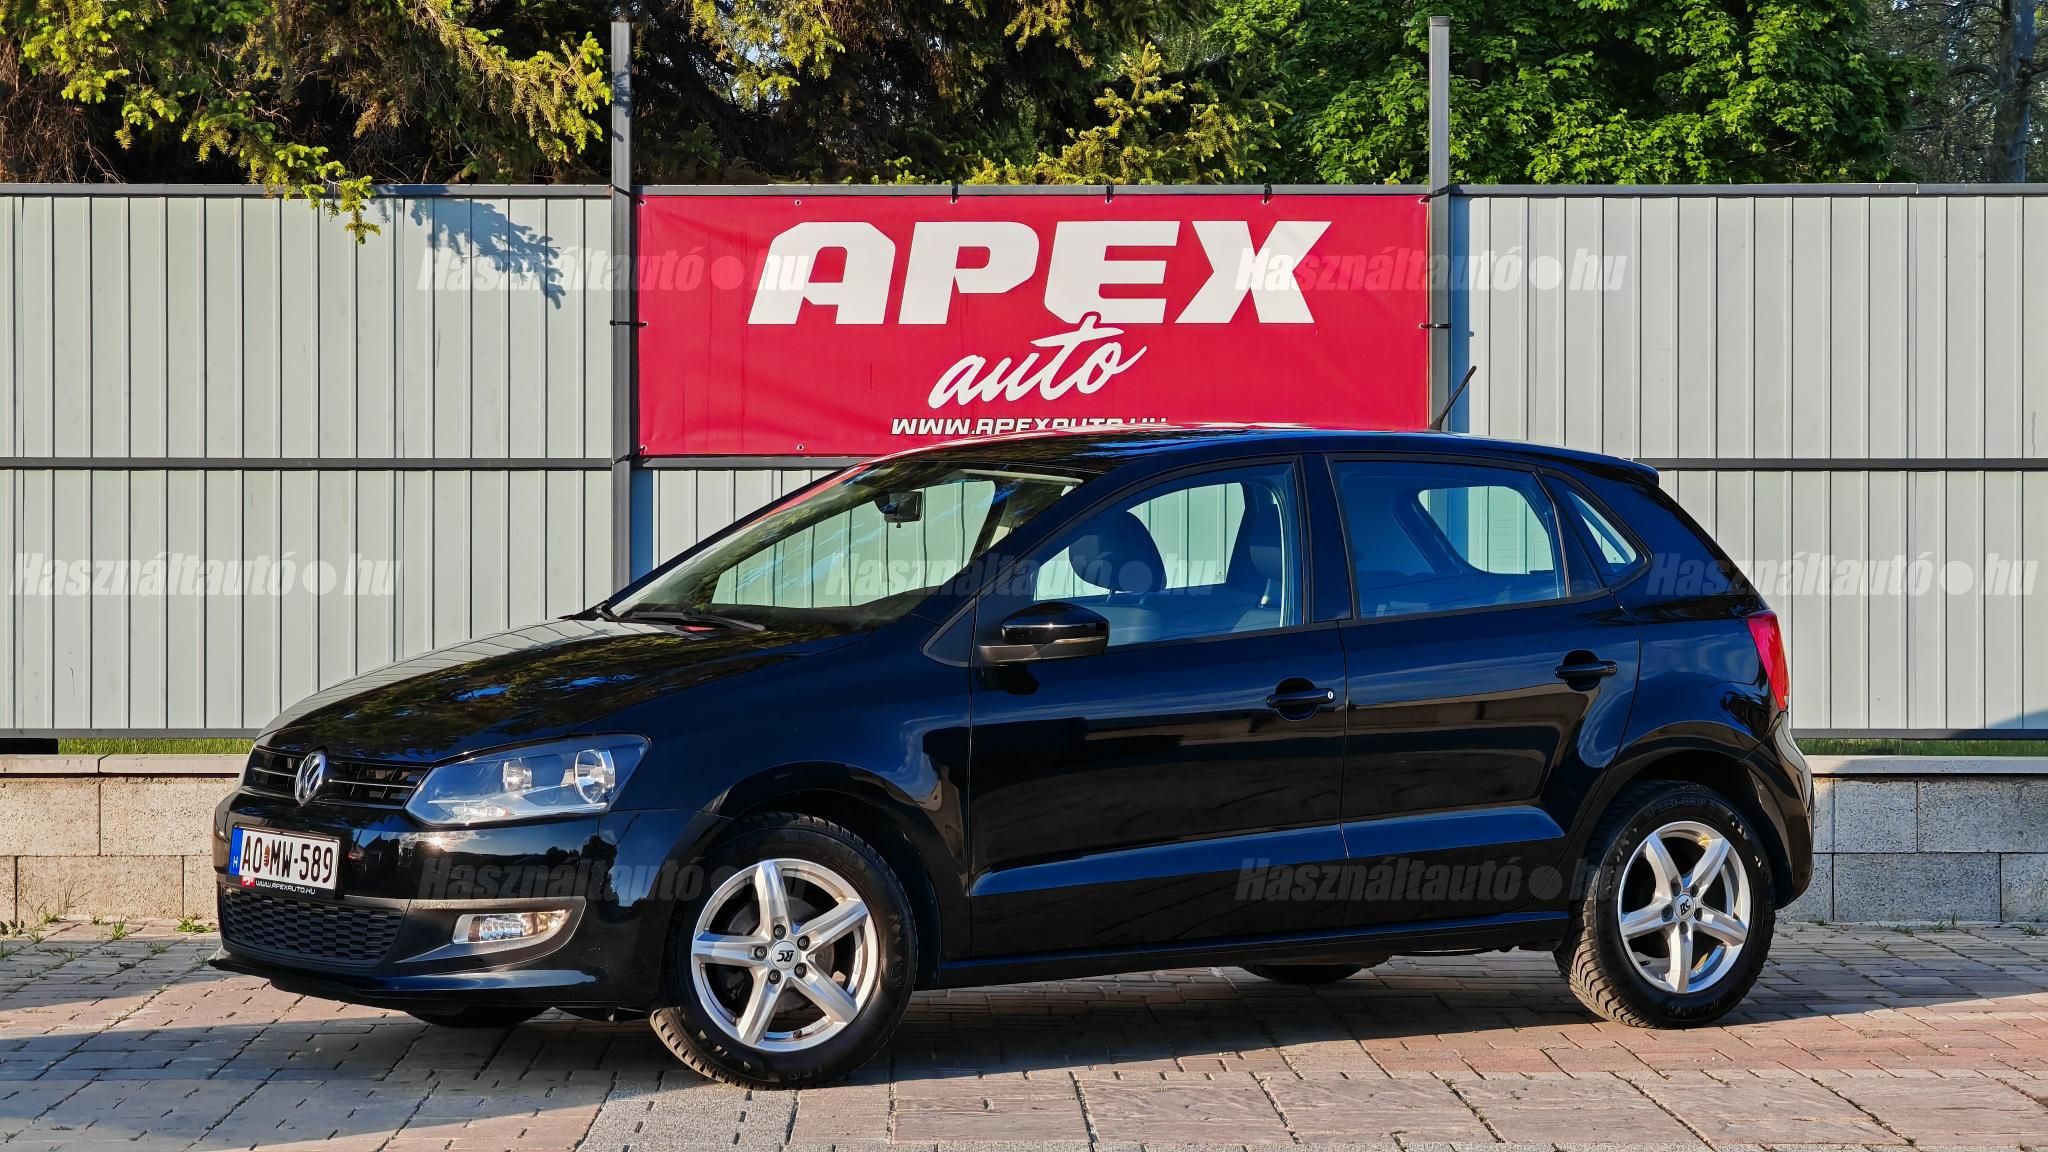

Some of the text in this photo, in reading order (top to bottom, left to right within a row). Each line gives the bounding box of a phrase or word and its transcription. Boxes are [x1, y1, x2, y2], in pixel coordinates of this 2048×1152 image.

[747, 220, 1333, 326] APEX
[927, 315, 1149, 410] auto
[890, 416, 1168, 436] WWW.APEXAU
[255, 879, 317, 895] WWW.APEXAUTO.HU
